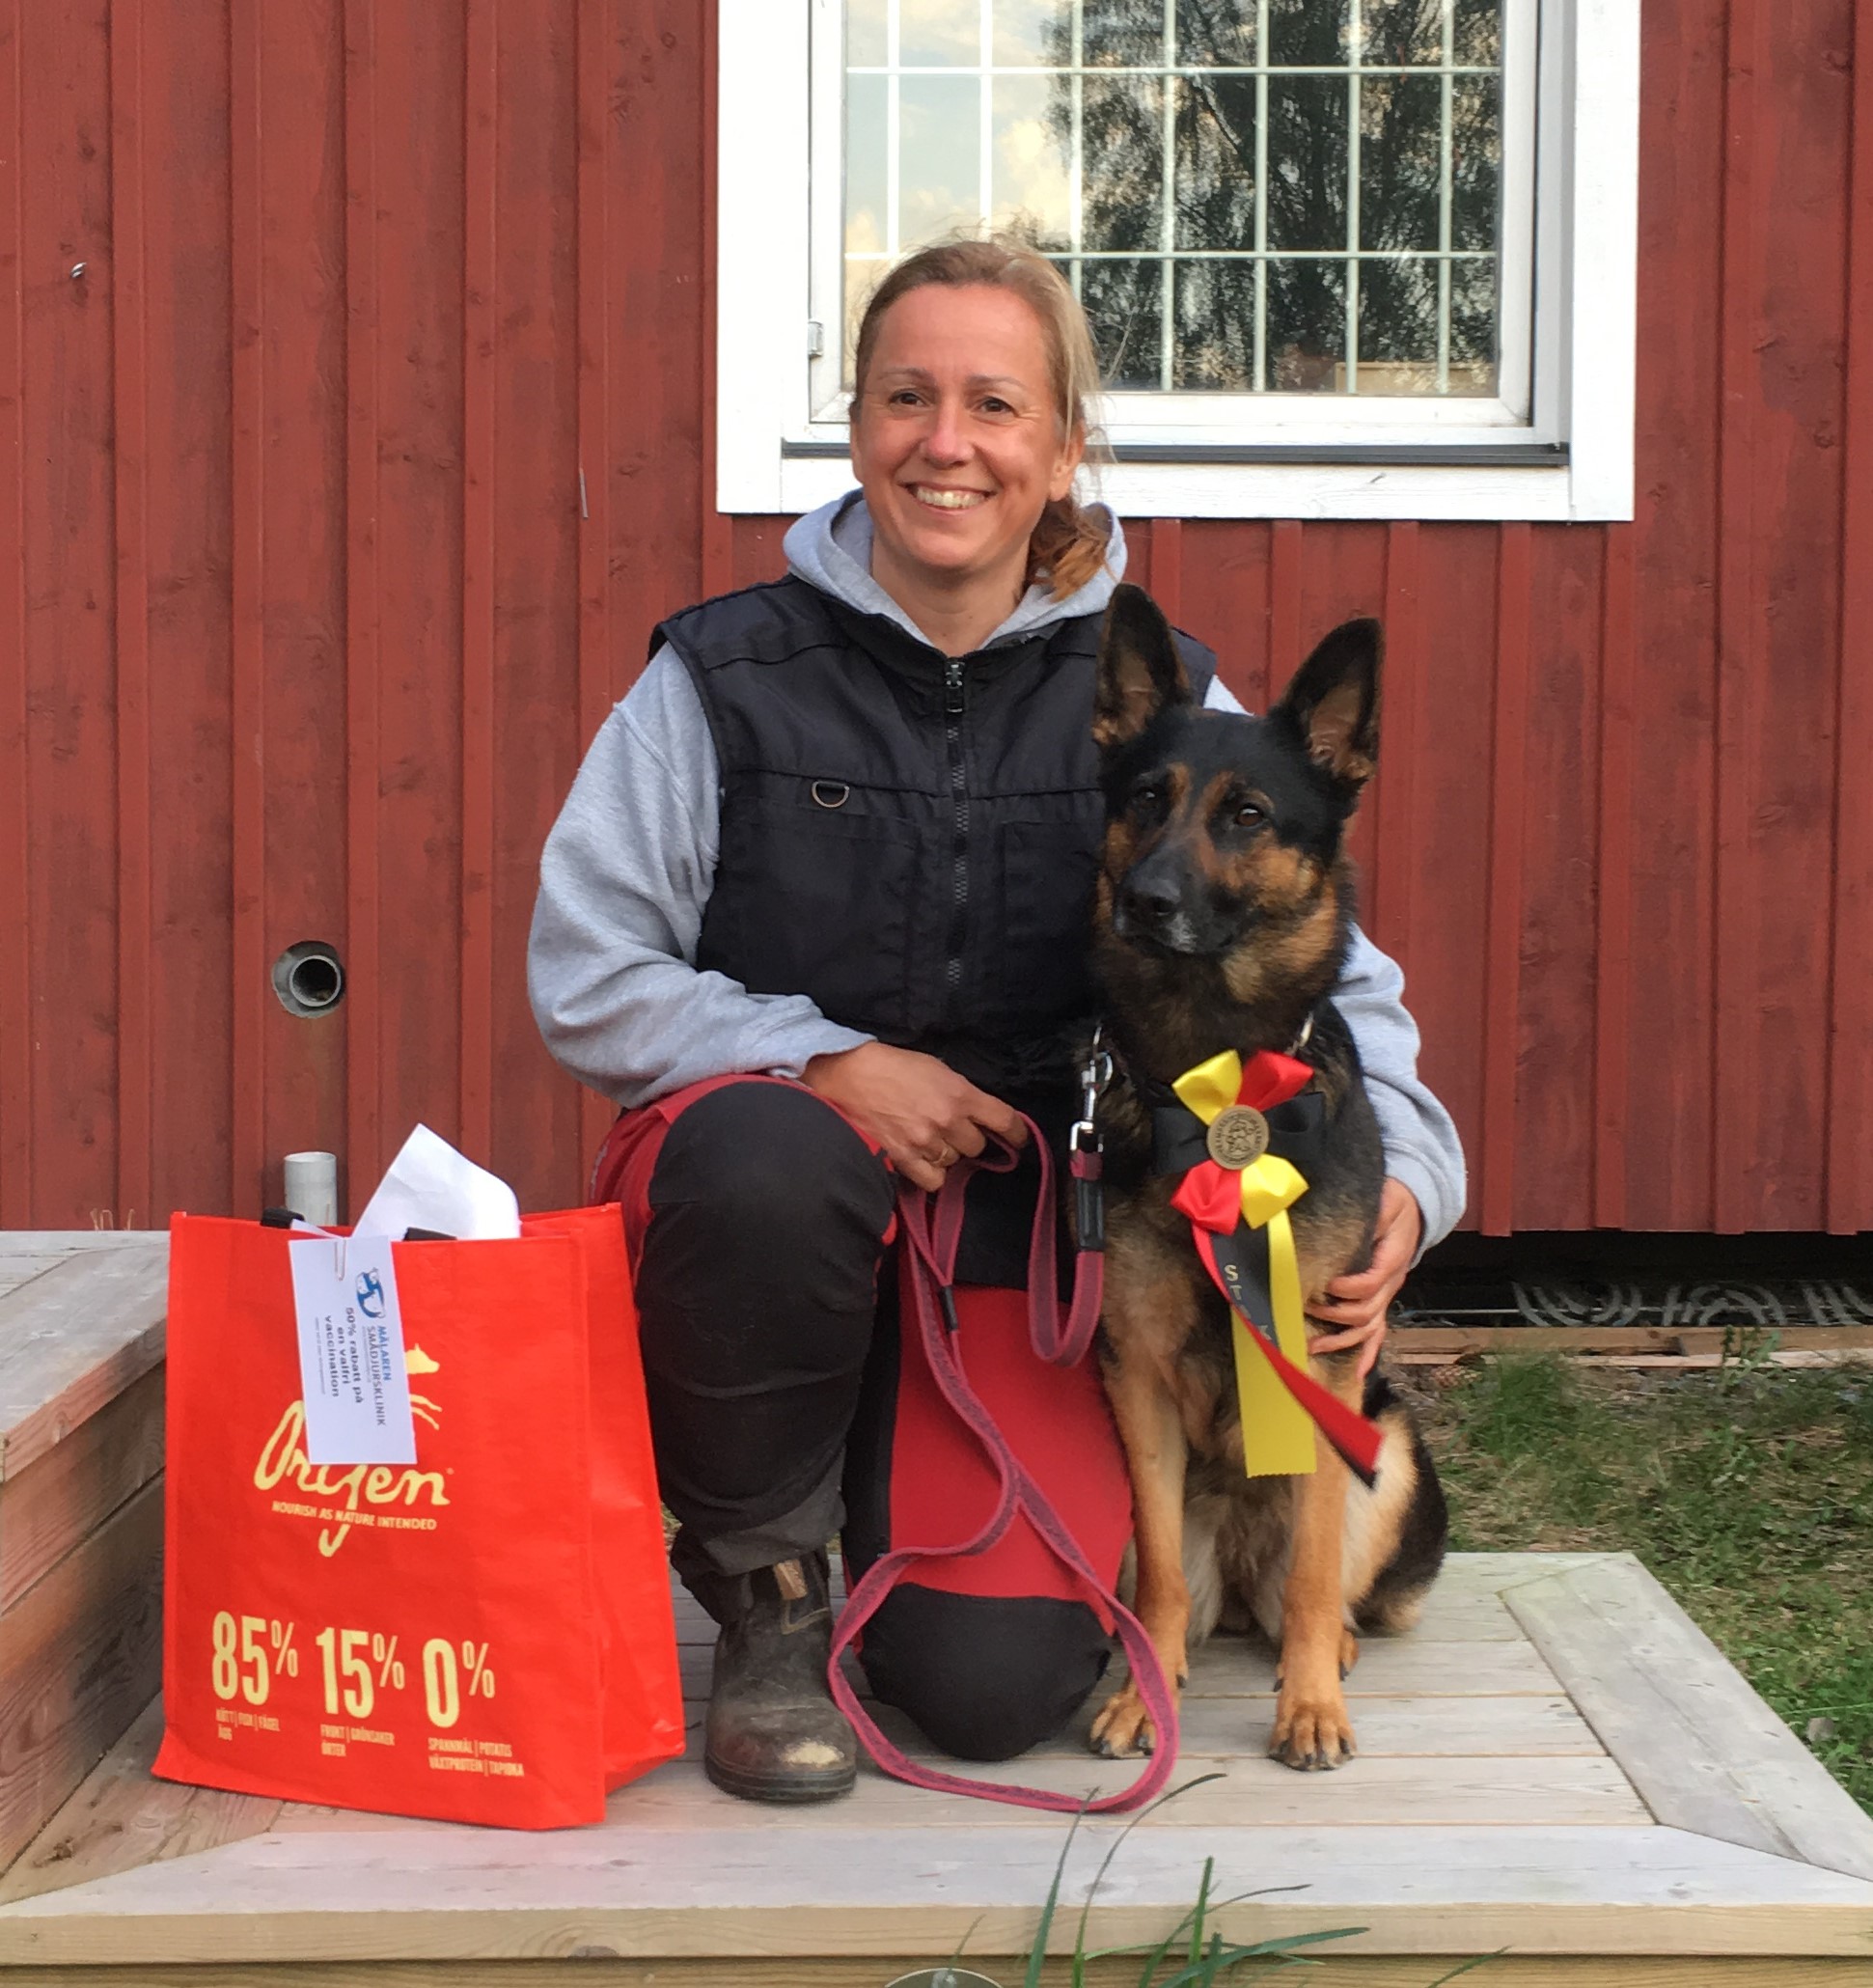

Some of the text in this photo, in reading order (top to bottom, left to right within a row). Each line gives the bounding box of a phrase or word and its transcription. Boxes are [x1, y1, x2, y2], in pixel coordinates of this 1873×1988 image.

[324, 1314, 339, 1398] vaccination
[337, 1326, 351, 1385] en valfri
[345, 1307, 365, 1404] 50% rabatt på
[367, 1325, 386, 1426] SMÅDJURSKLINIK
[377, 1325, 392, 1382] MÅLAREN
[271, 1500, 437, 1531] NOURISH AS NATURE INTENDED
[211, 1611, 496, 1728] 85% 15% 0%
